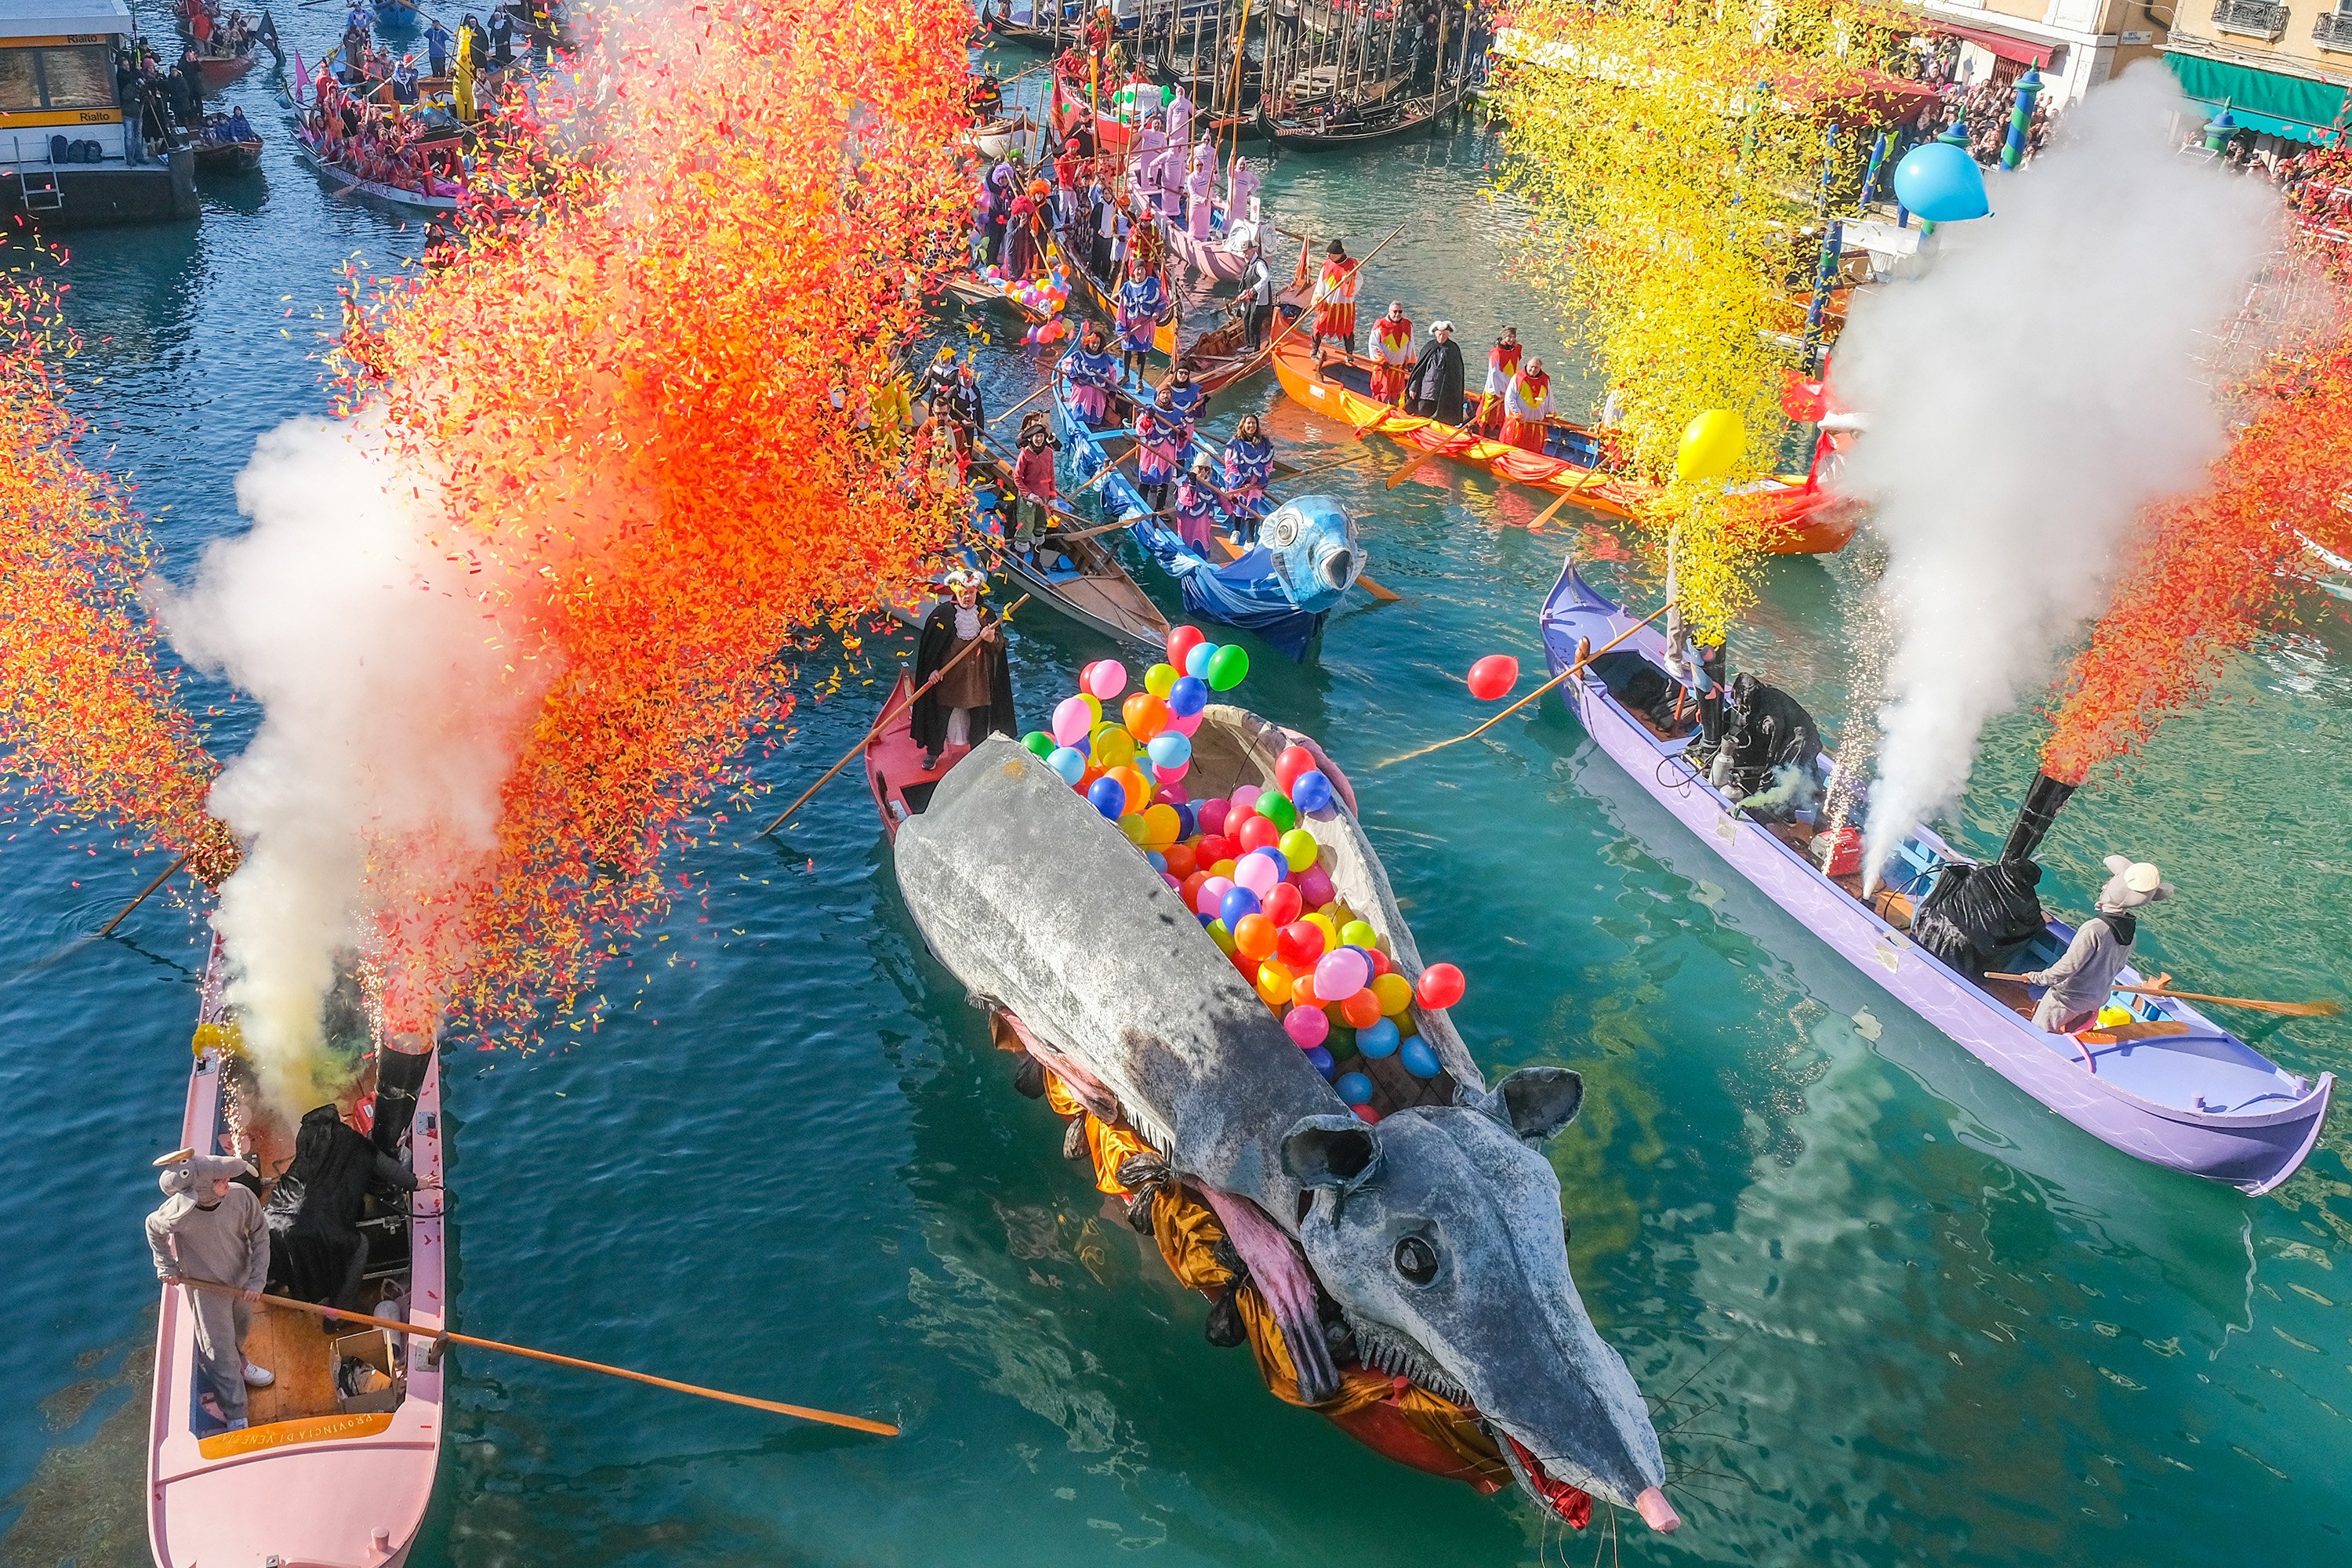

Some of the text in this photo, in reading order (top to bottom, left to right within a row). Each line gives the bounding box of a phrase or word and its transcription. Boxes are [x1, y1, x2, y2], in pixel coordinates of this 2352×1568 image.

[67, 34, 97, 43] Rialto
[80, 112, 110, 122] Rialto
[299, 1413, 373, 1440] PROVINCIA
[279, 1432, 295, 1443] DI
